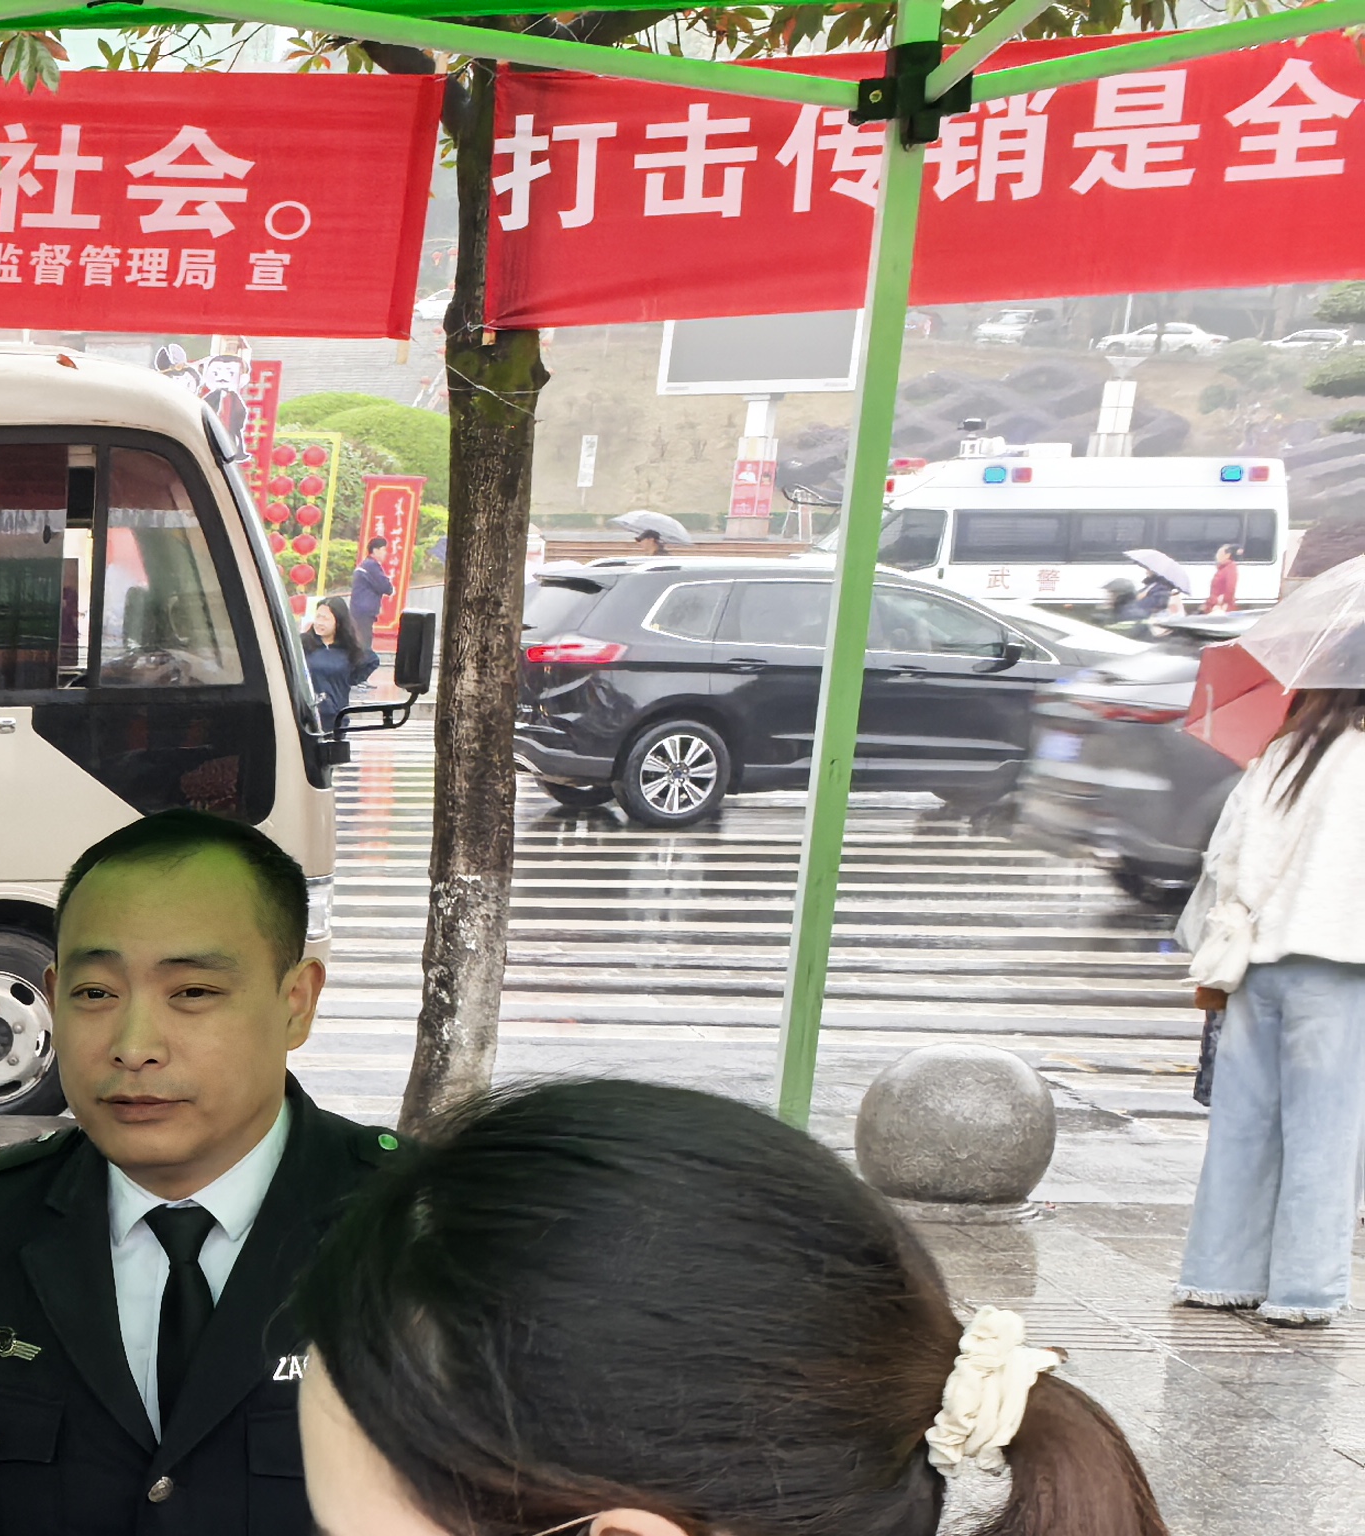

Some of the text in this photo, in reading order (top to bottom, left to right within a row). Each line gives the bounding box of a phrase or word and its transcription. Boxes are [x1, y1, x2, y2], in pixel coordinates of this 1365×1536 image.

[492, 58, 1362, 231] 打击传销是全
[245, 250, 293, 293] 宣
[272, 1354, 309, 1381] ZA
